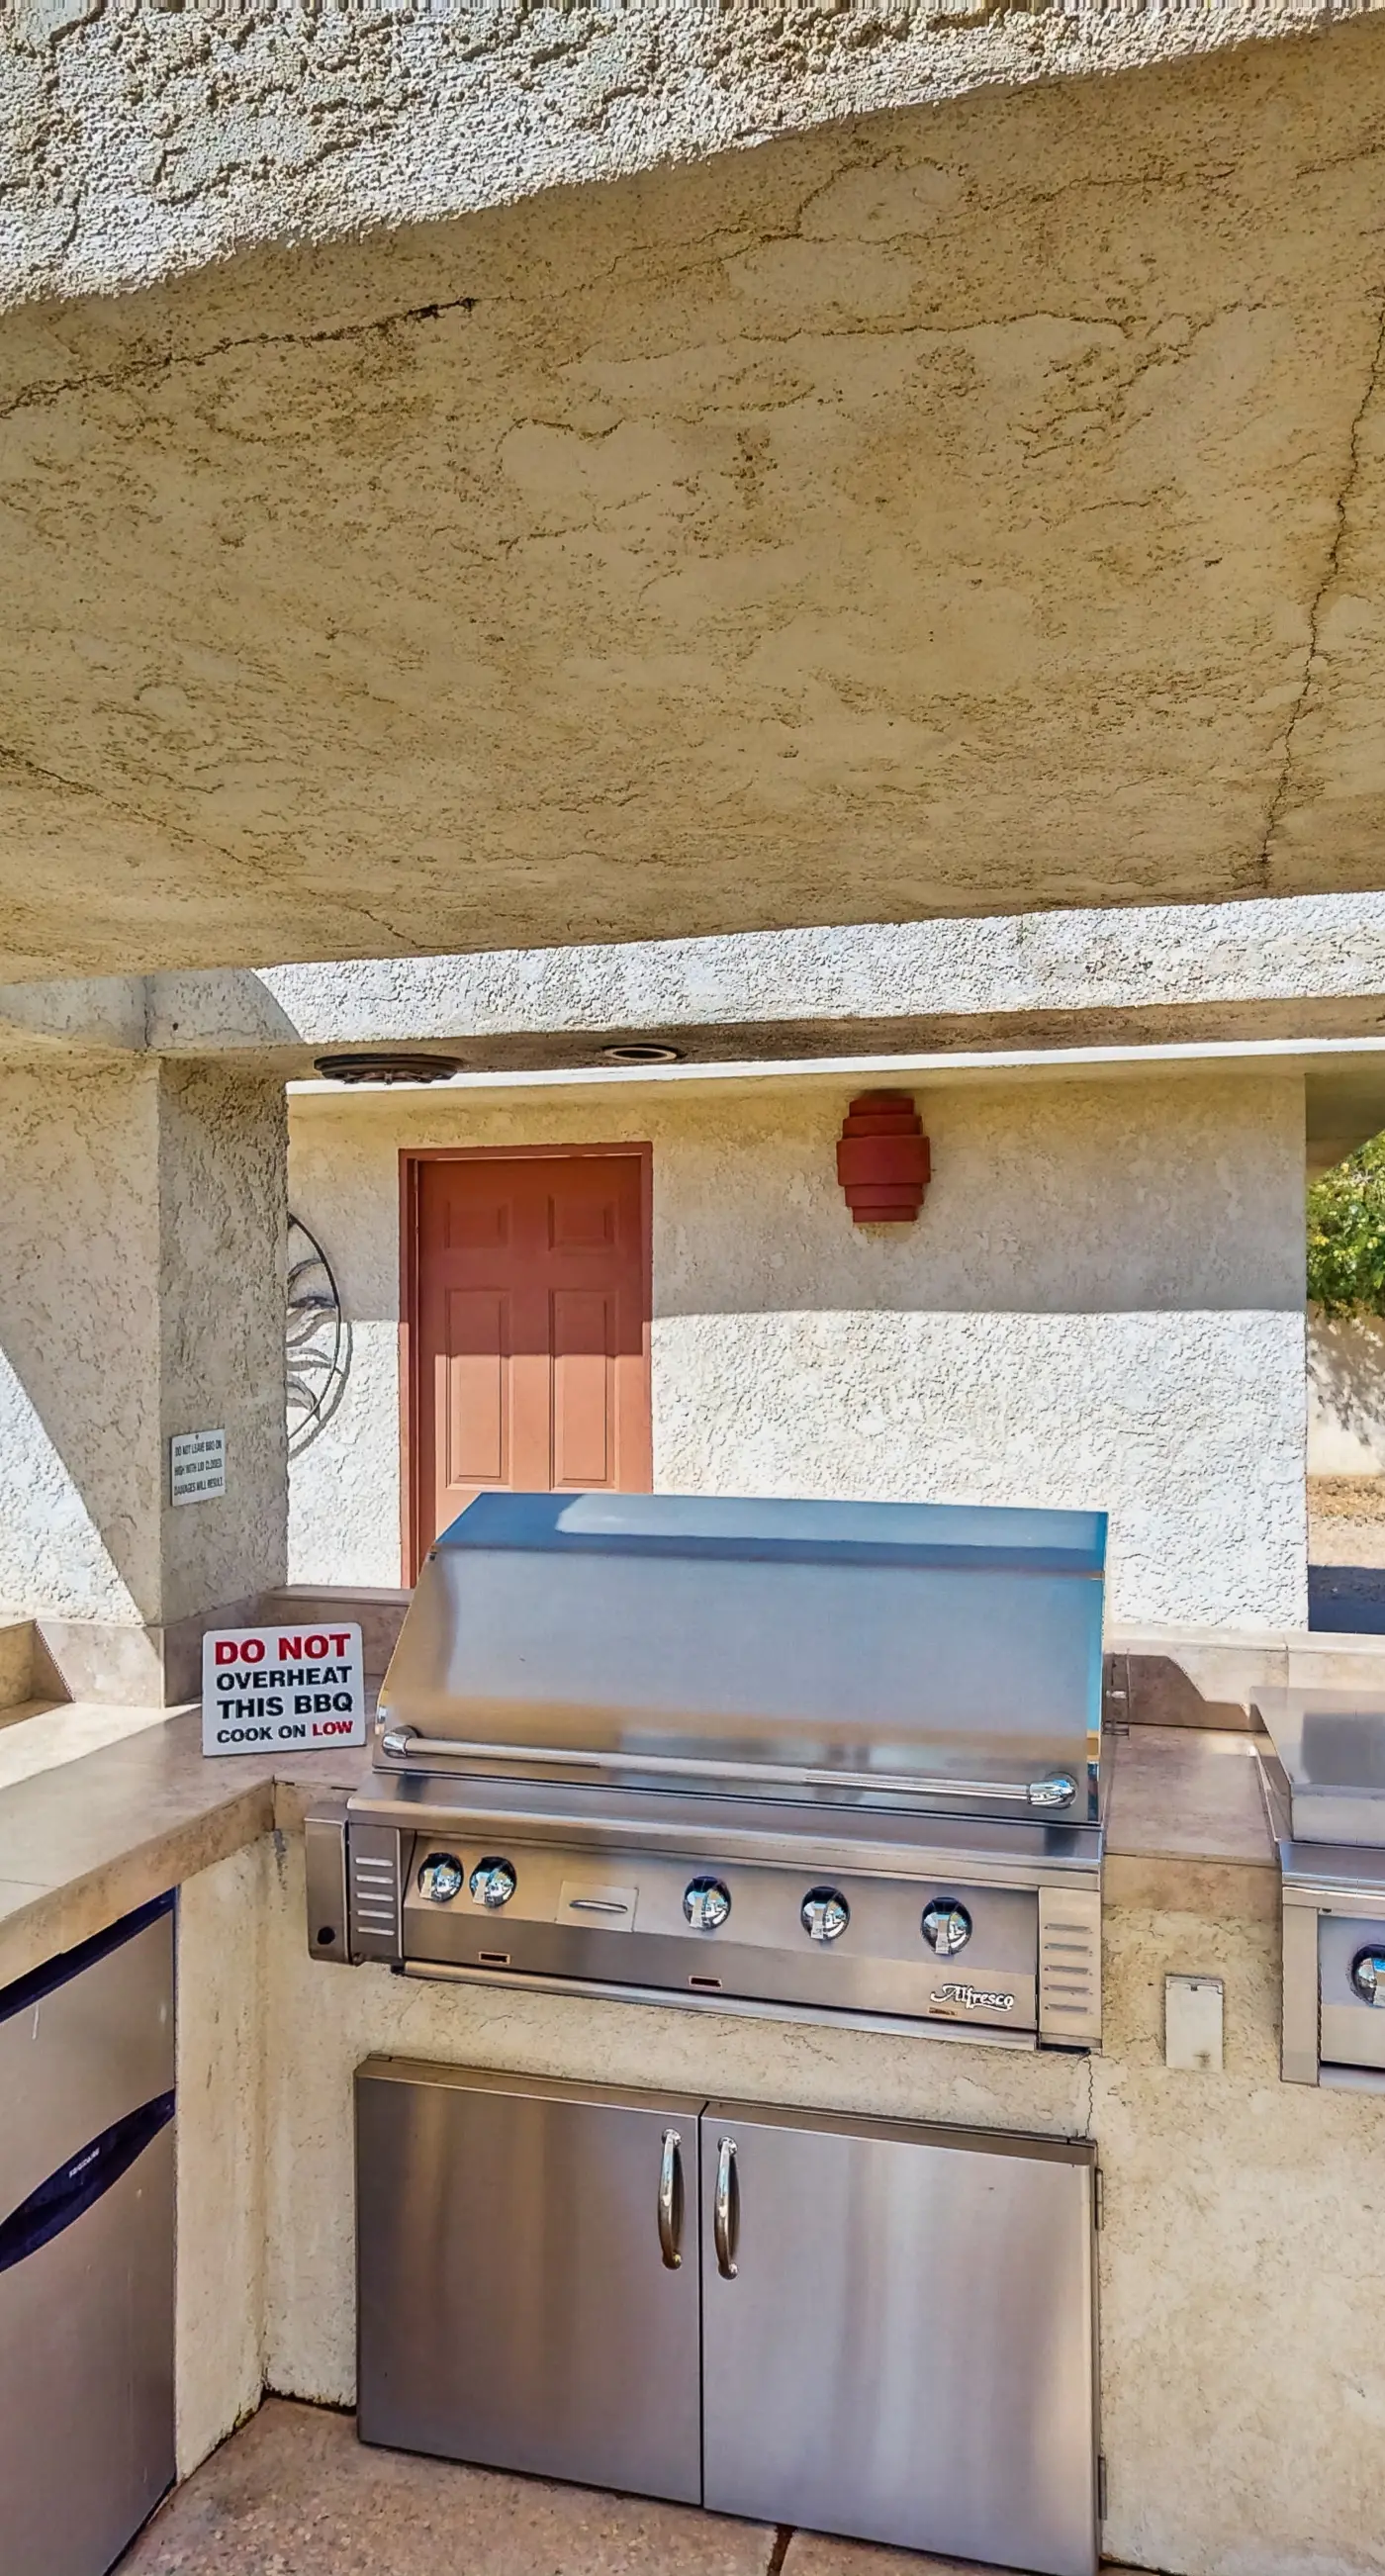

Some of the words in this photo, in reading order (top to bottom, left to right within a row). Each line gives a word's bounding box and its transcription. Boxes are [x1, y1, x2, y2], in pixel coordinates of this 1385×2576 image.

[192, 1441, 205, 1453] LEAVE
[215, 1639, 265, 1665] DO
[278, 1633, 351, 1661] NOT
[217, 1666, 352, 1691] OVERHEAT
[217, 1697, 284, 1719] THIS
[295, 1693, 353, 1714] BBQ
[217, 1726, 273, 1743] COOK
[278, 1724, 307, 1739] ON
[313, 1720, 353, 1736] LOW
[930, 1982, 1014, 2012] Alfresco
